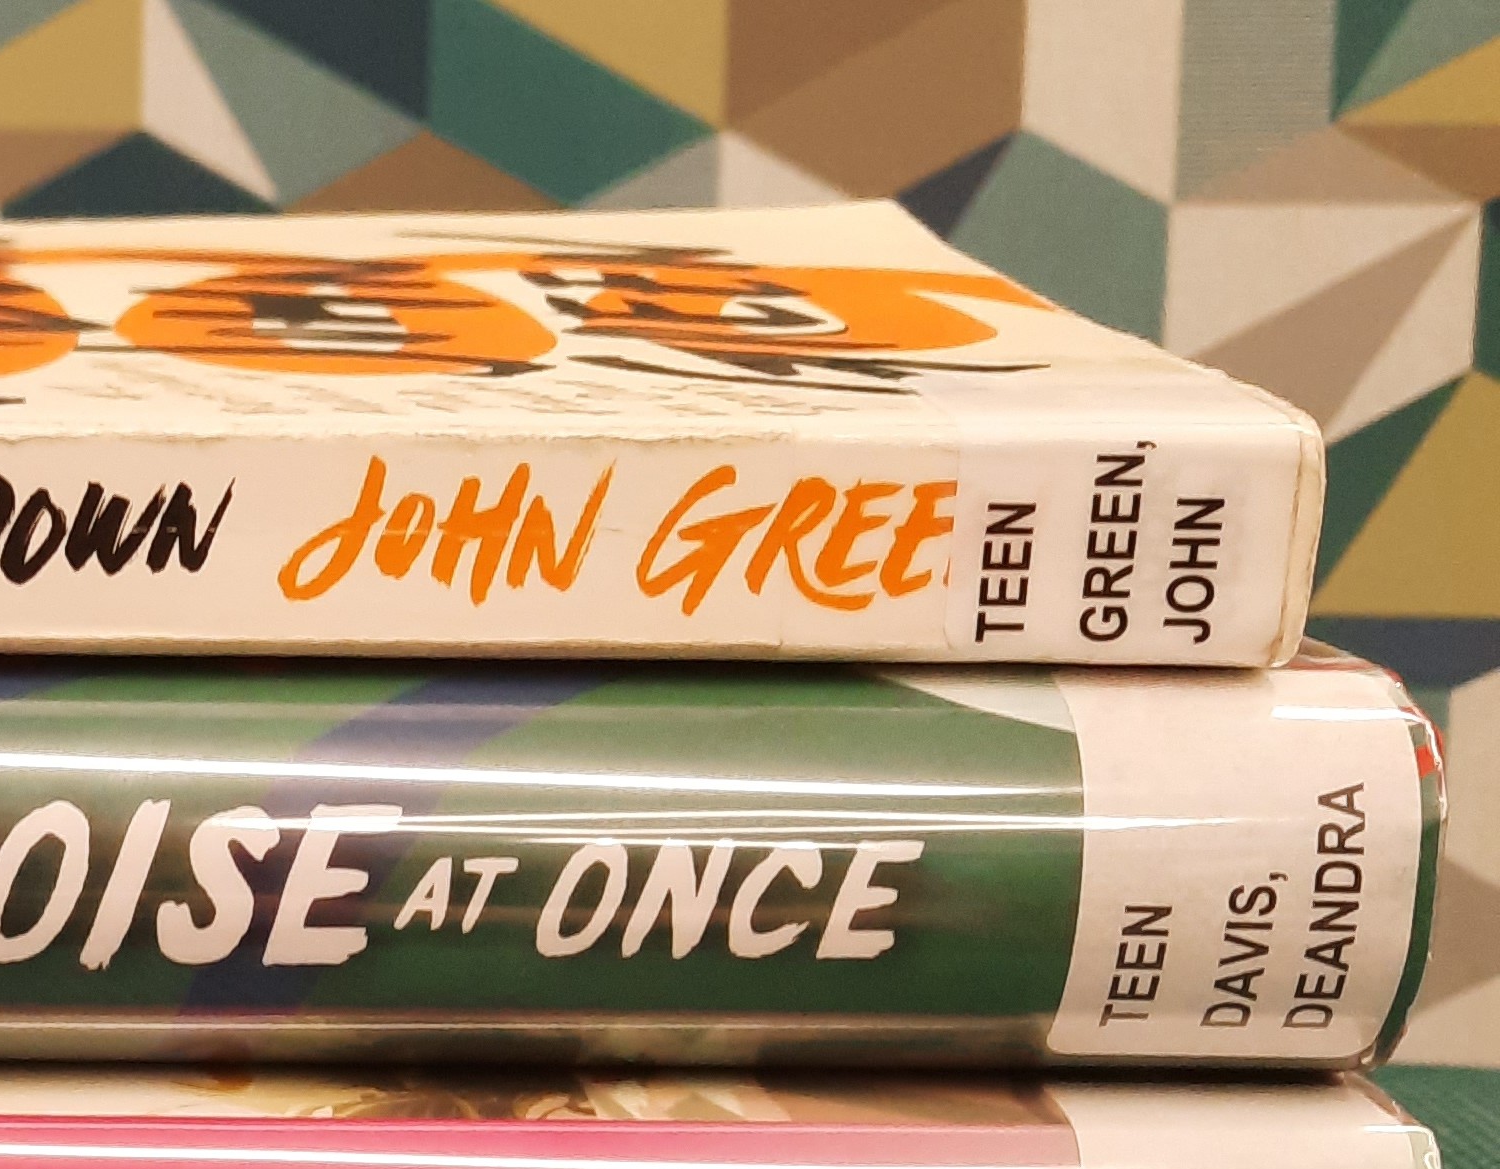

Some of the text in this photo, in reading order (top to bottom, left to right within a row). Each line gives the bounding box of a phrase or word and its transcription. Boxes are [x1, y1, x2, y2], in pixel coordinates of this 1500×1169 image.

[278, 454, 958, 617] JOHN GREE
[975, 501, 1037, 643] TEEN
[1079, 440, 1158, 641] GREEN,
[1163, 496, 1226, 645] JOHN
[394, 855, 519, 934] AT
[535, 836, 926, 960] ONCE
[1099, 904, 1174, 1029] TEEN
[1200, 871, 1290, 1030] DAVIS,
[1280, 781, 1366, 1031] DEANDRA
